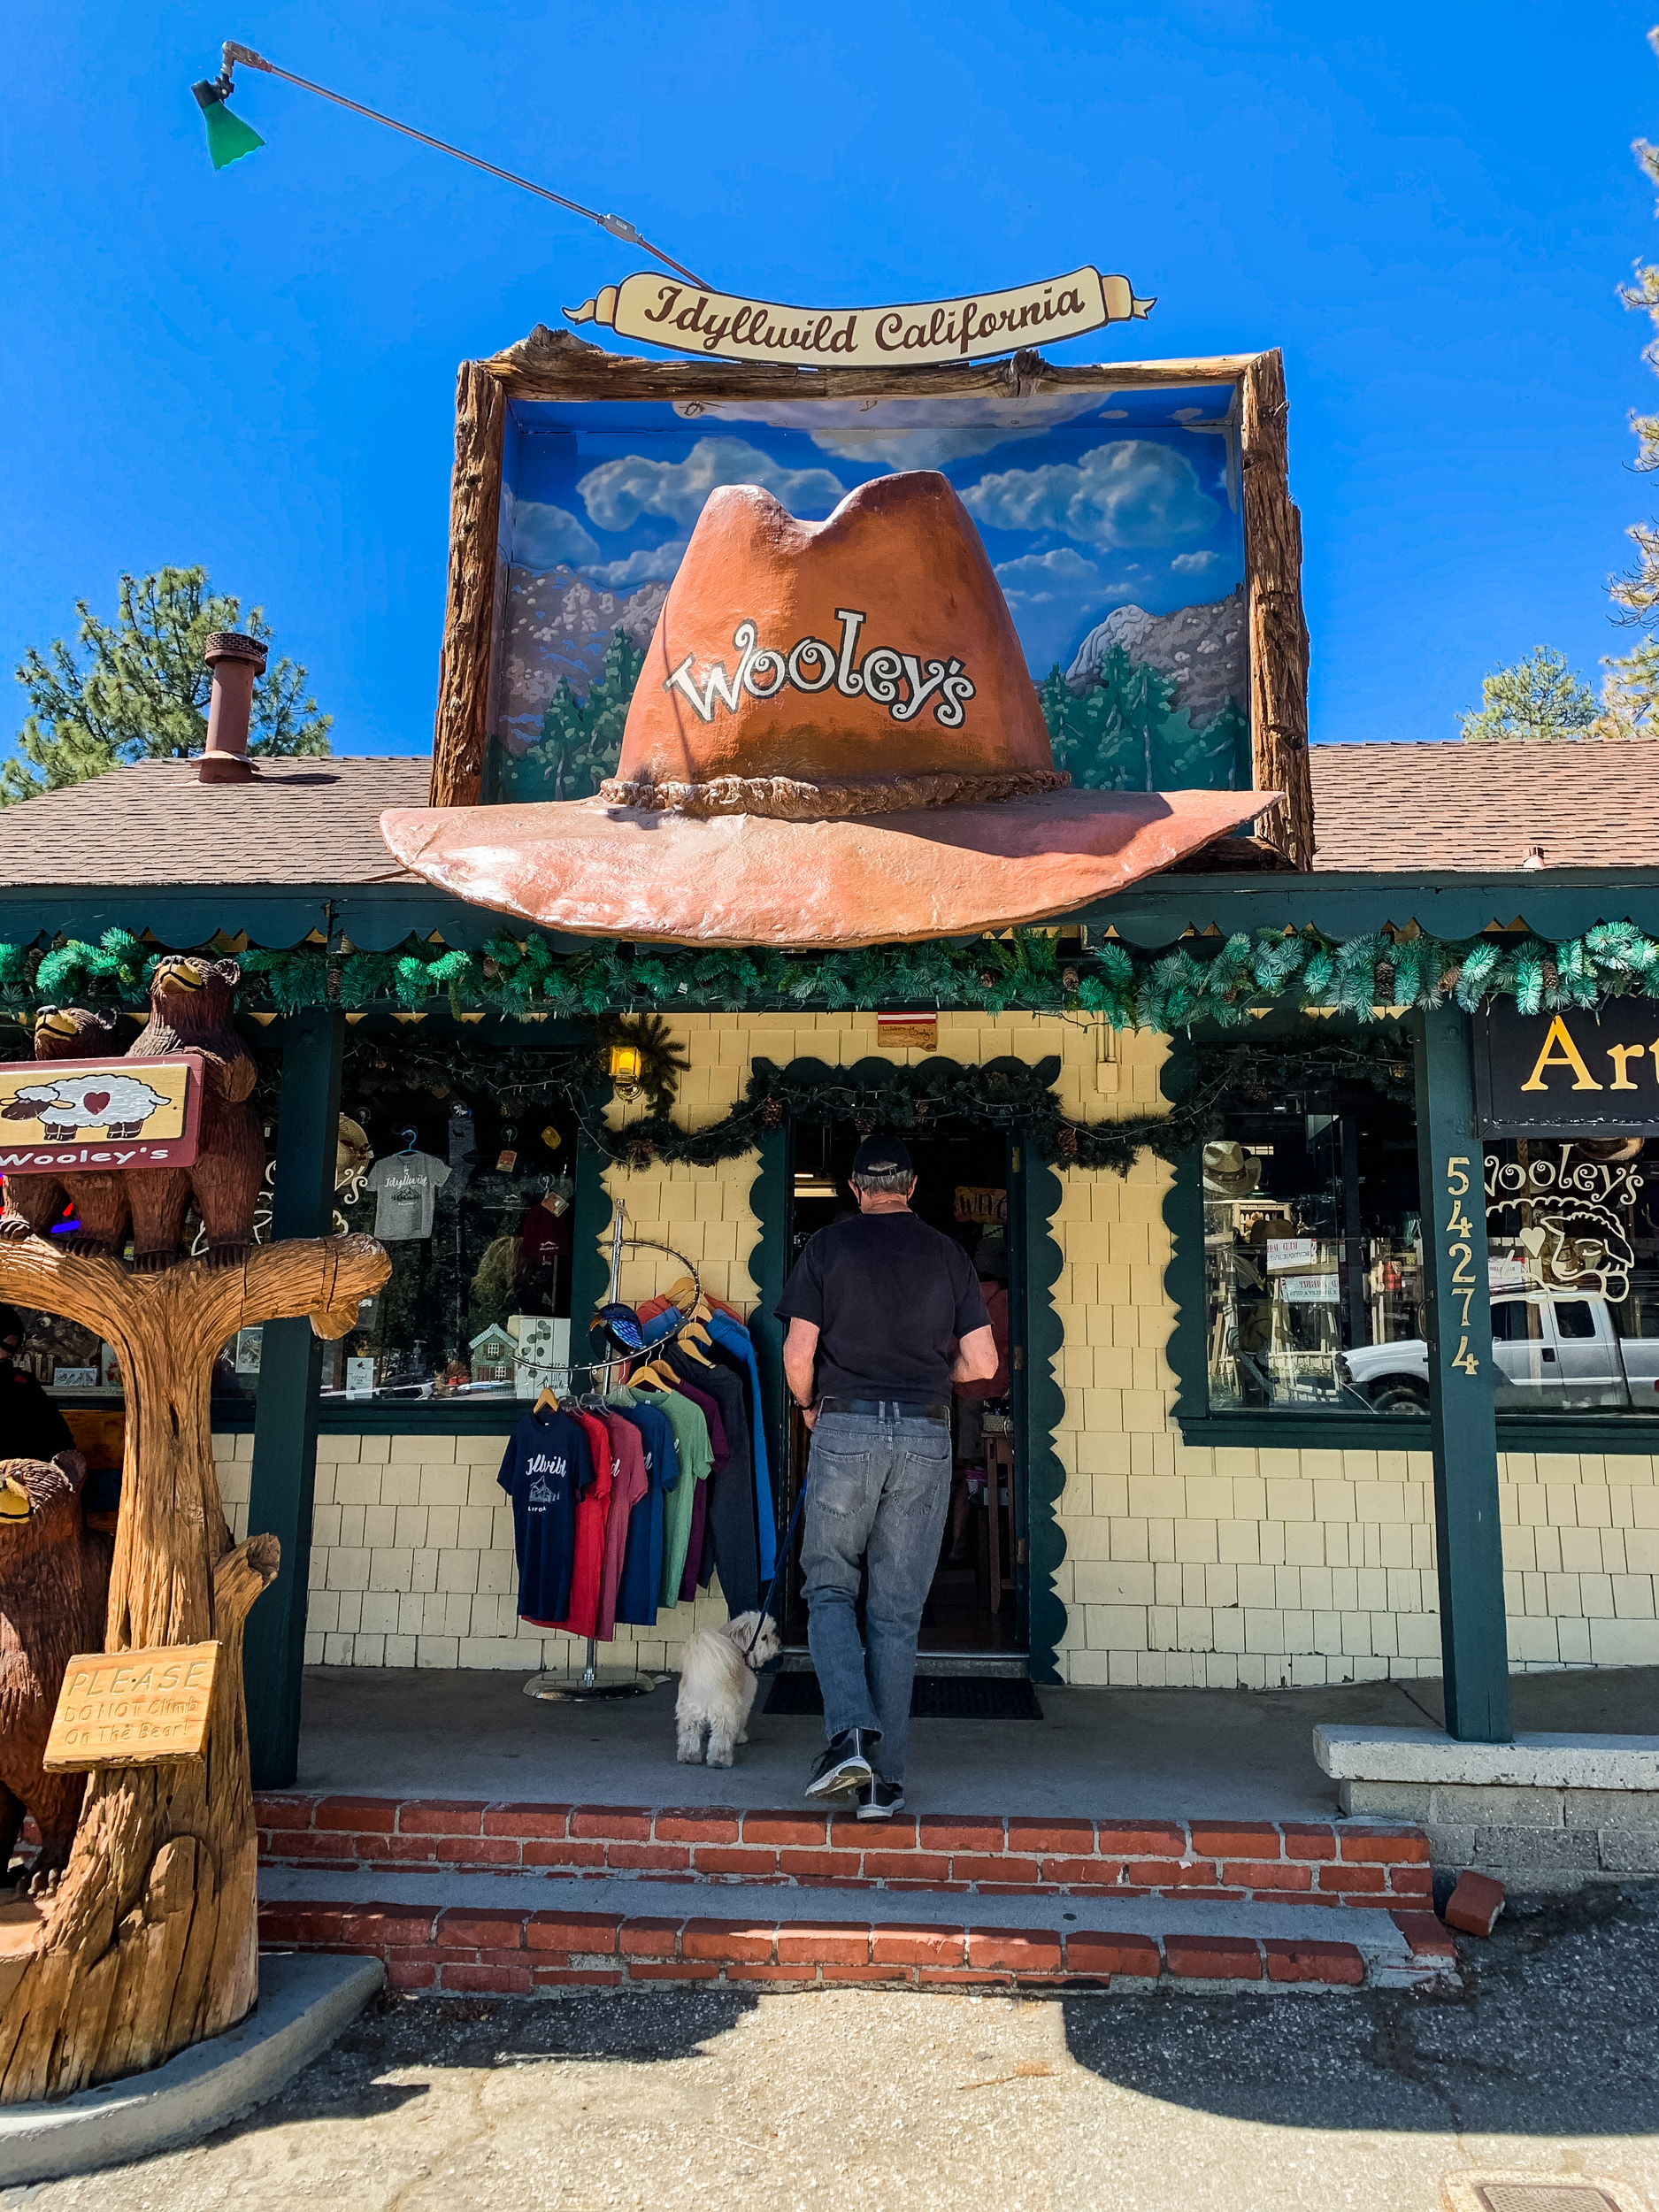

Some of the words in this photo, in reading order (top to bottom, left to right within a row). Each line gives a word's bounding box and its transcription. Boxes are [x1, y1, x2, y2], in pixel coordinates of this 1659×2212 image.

[644, 286, 858, 352] Idyllwild
[875, 287, 1085, 354] California
[663, 608, 976, 728] Wooley's
[0, 1147, 169, 1167] Wooley's
[67, 1661, 208, 1697] PLEASE
[97, 1701, 146, 1721] NOT
[148, 1696, 198, 1717] Climb
[65, 1728, 90, 1745] On
[99, 1724, 130, 1742] The
[139, 1719, 191, 1740] Bear!
